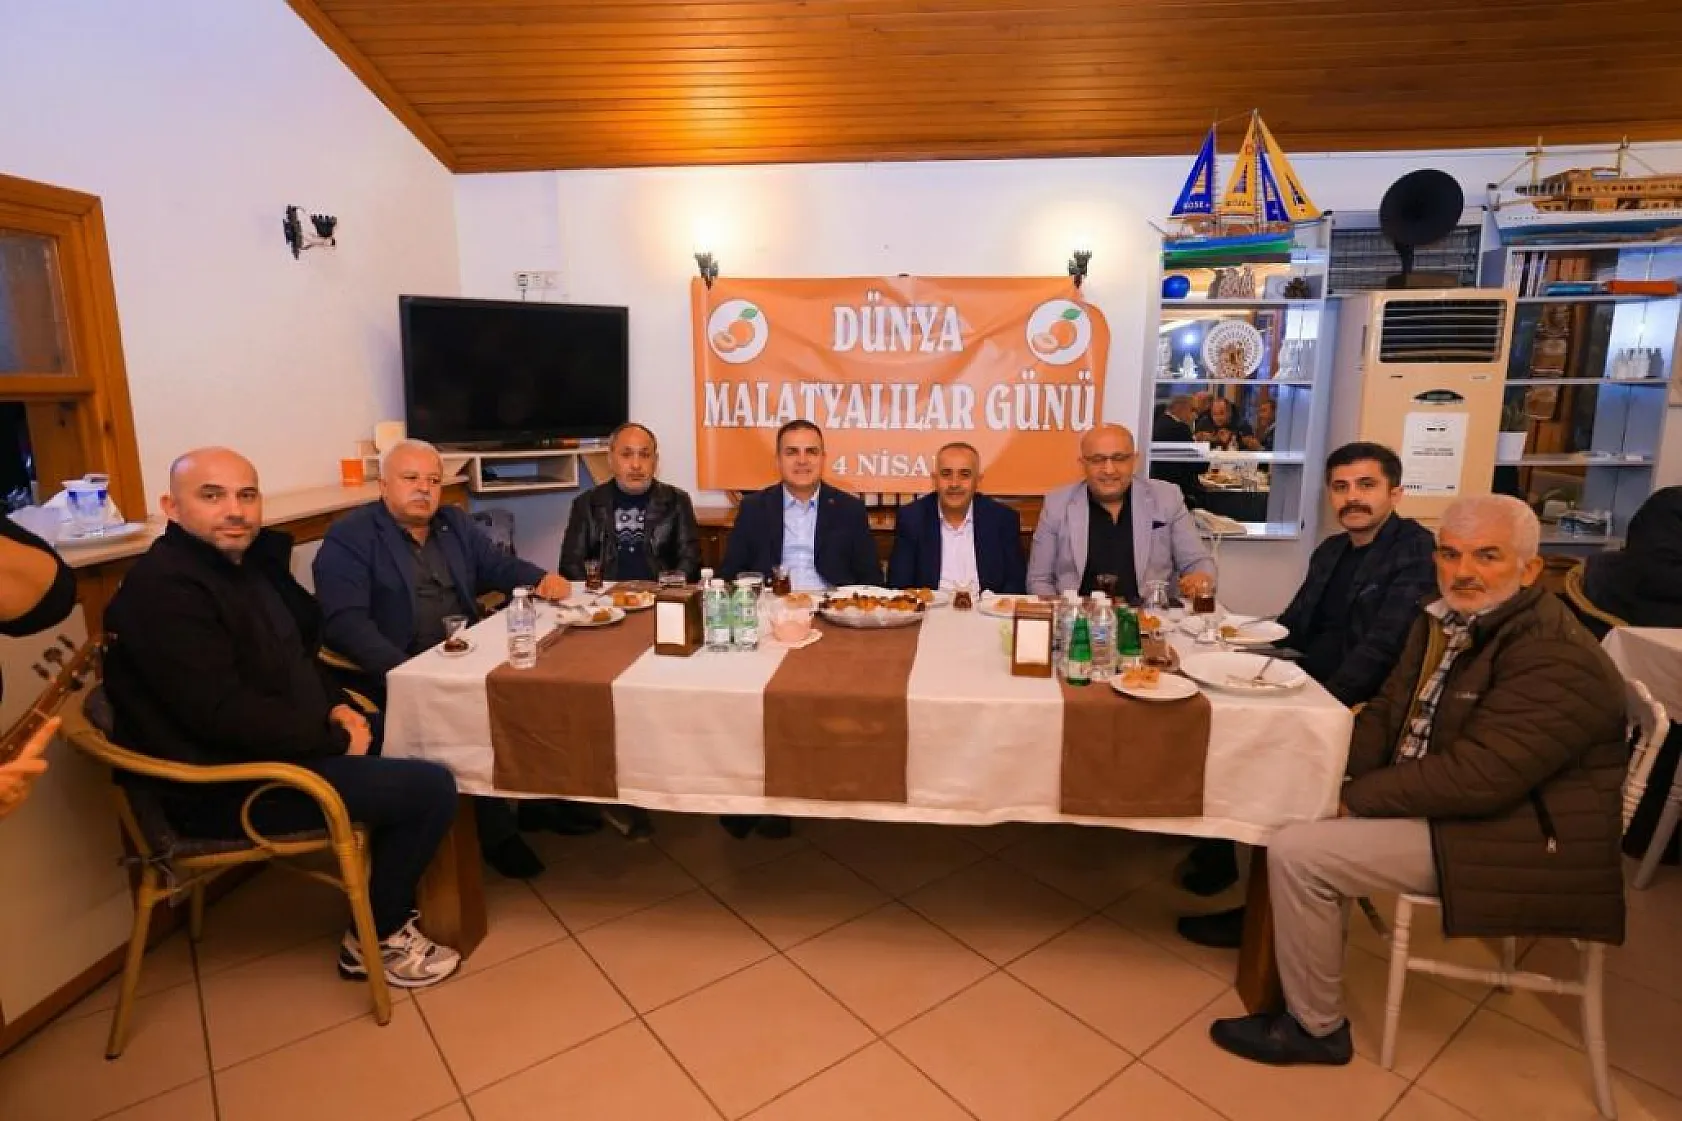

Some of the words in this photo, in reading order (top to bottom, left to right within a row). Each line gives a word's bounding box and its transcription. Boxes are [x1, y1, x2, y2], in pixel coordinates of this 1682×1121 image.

[832, 290, 964, 352] DÜNYA
[703, 380, 975, 431] MALATYALILAR
[984, 369, 1096, 432] GÜNÜ
[832, 455, 848, 475] 4
[857, 449, 937, 477] NİSA
